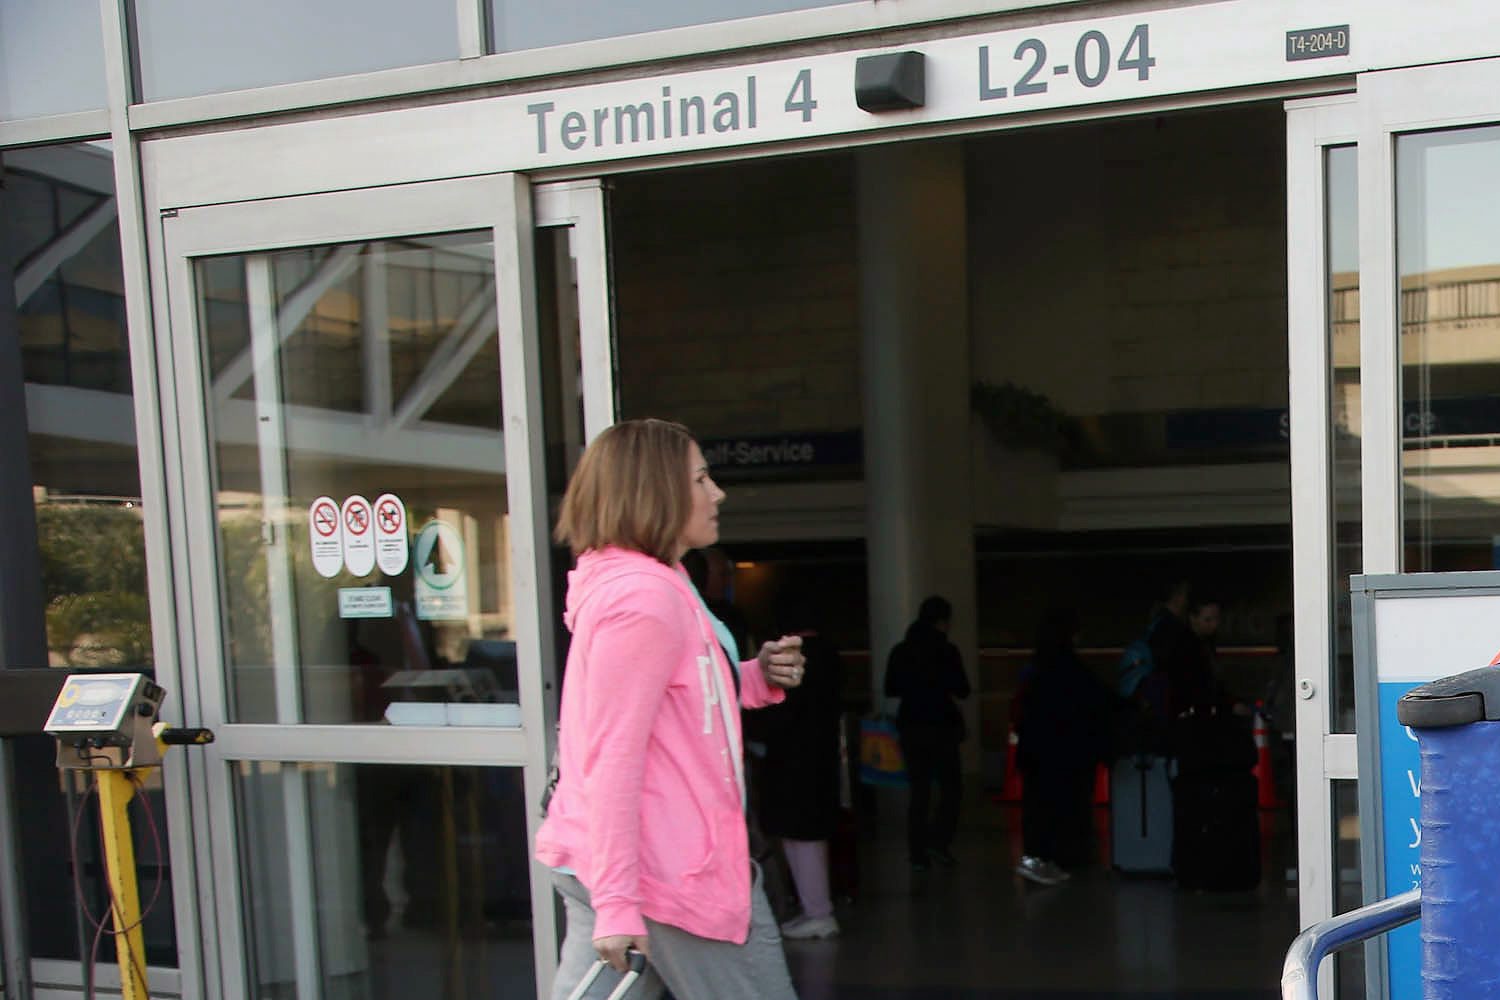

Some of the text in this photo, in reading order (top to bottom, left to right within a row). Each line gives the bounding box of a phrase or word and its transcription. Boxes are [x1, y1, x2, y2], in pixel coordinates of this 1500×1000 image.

[978, 24, 1156, 102] L2-04
[1290, 32, 1346, 54] T4-204-D
[528, 69, 817, 154] Terminal 4
